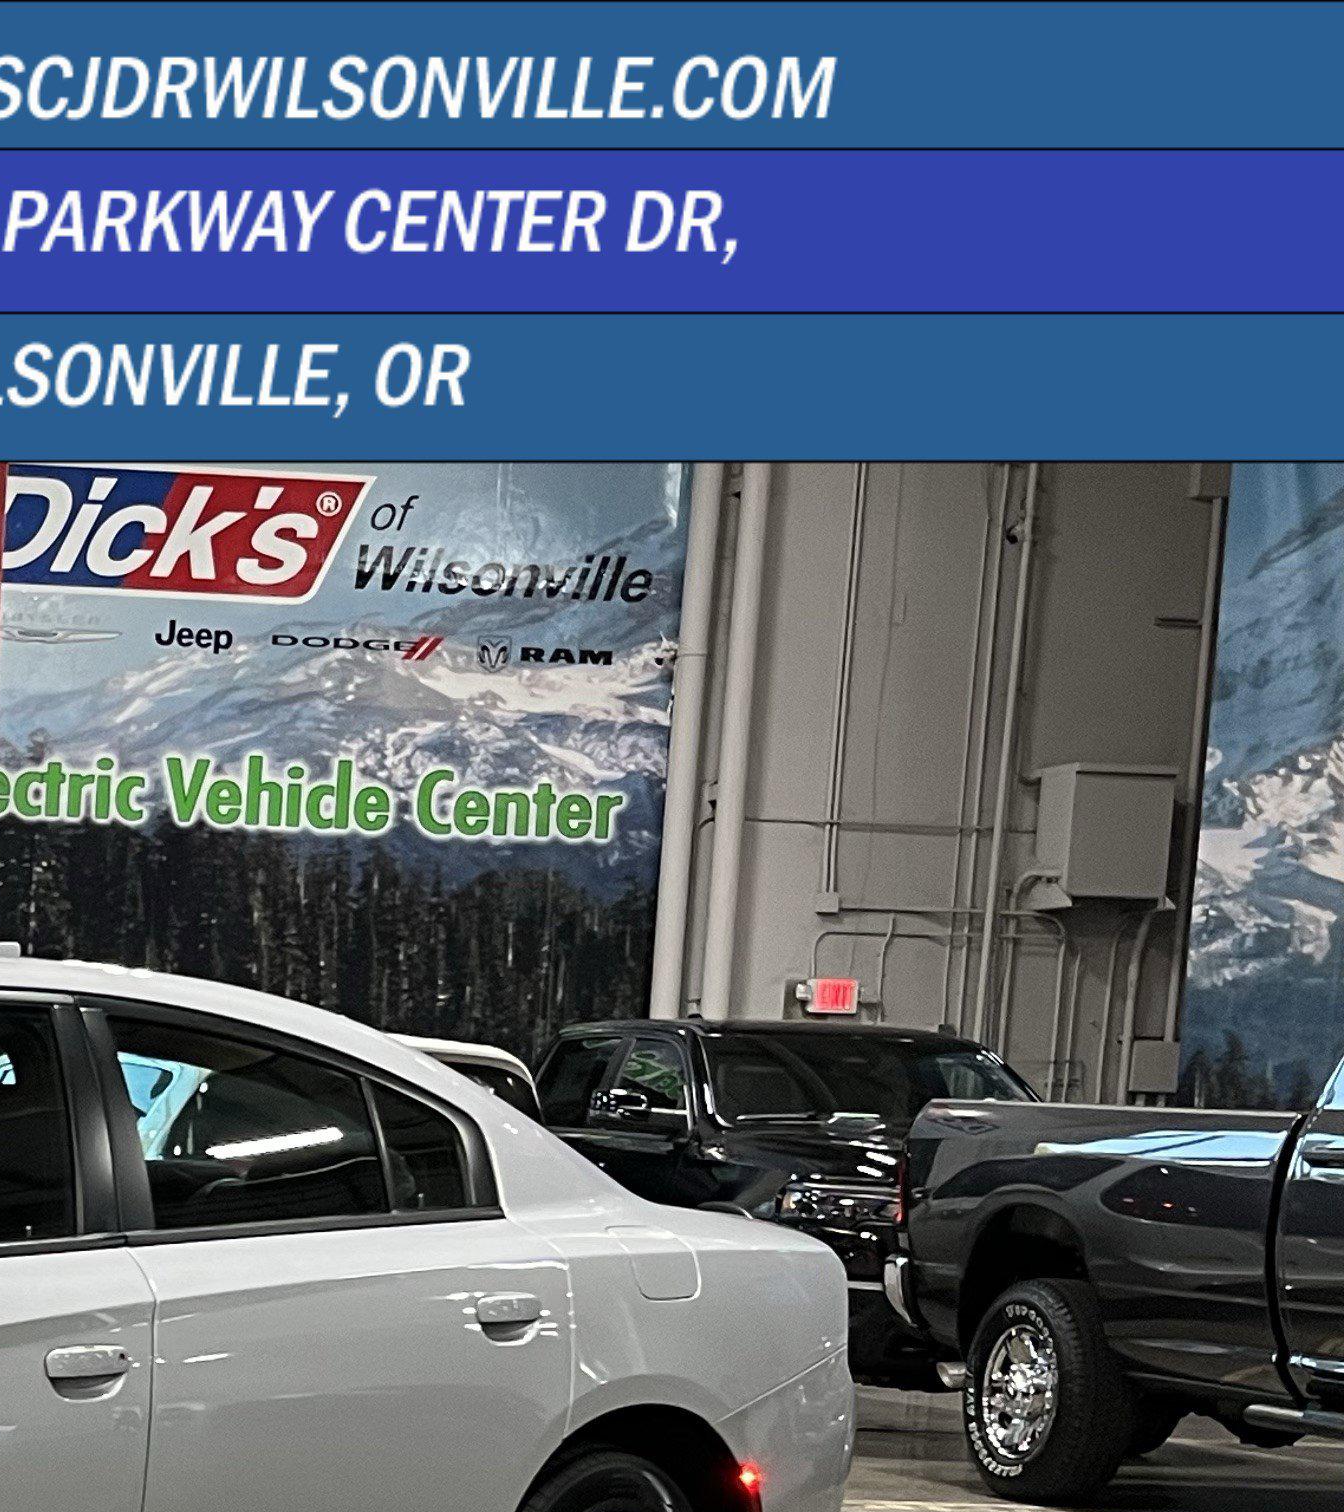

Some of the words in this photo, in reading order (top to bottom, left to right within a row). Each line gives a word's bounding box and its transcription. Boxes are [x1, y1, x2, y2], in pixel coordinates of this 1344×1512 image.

[2, 475, 319, 586] Dick's
[370, 495, 419, 531] of
[354, 543, 653, 604] Wilsonville
[155, 619, 234, 654] Jeep
[271, 634, 412, 652] DODGE
[520, 646, 613, 666] RAM
[166, 755, 391, 831] Vehicle
[417, 768, 623, 840] Center
